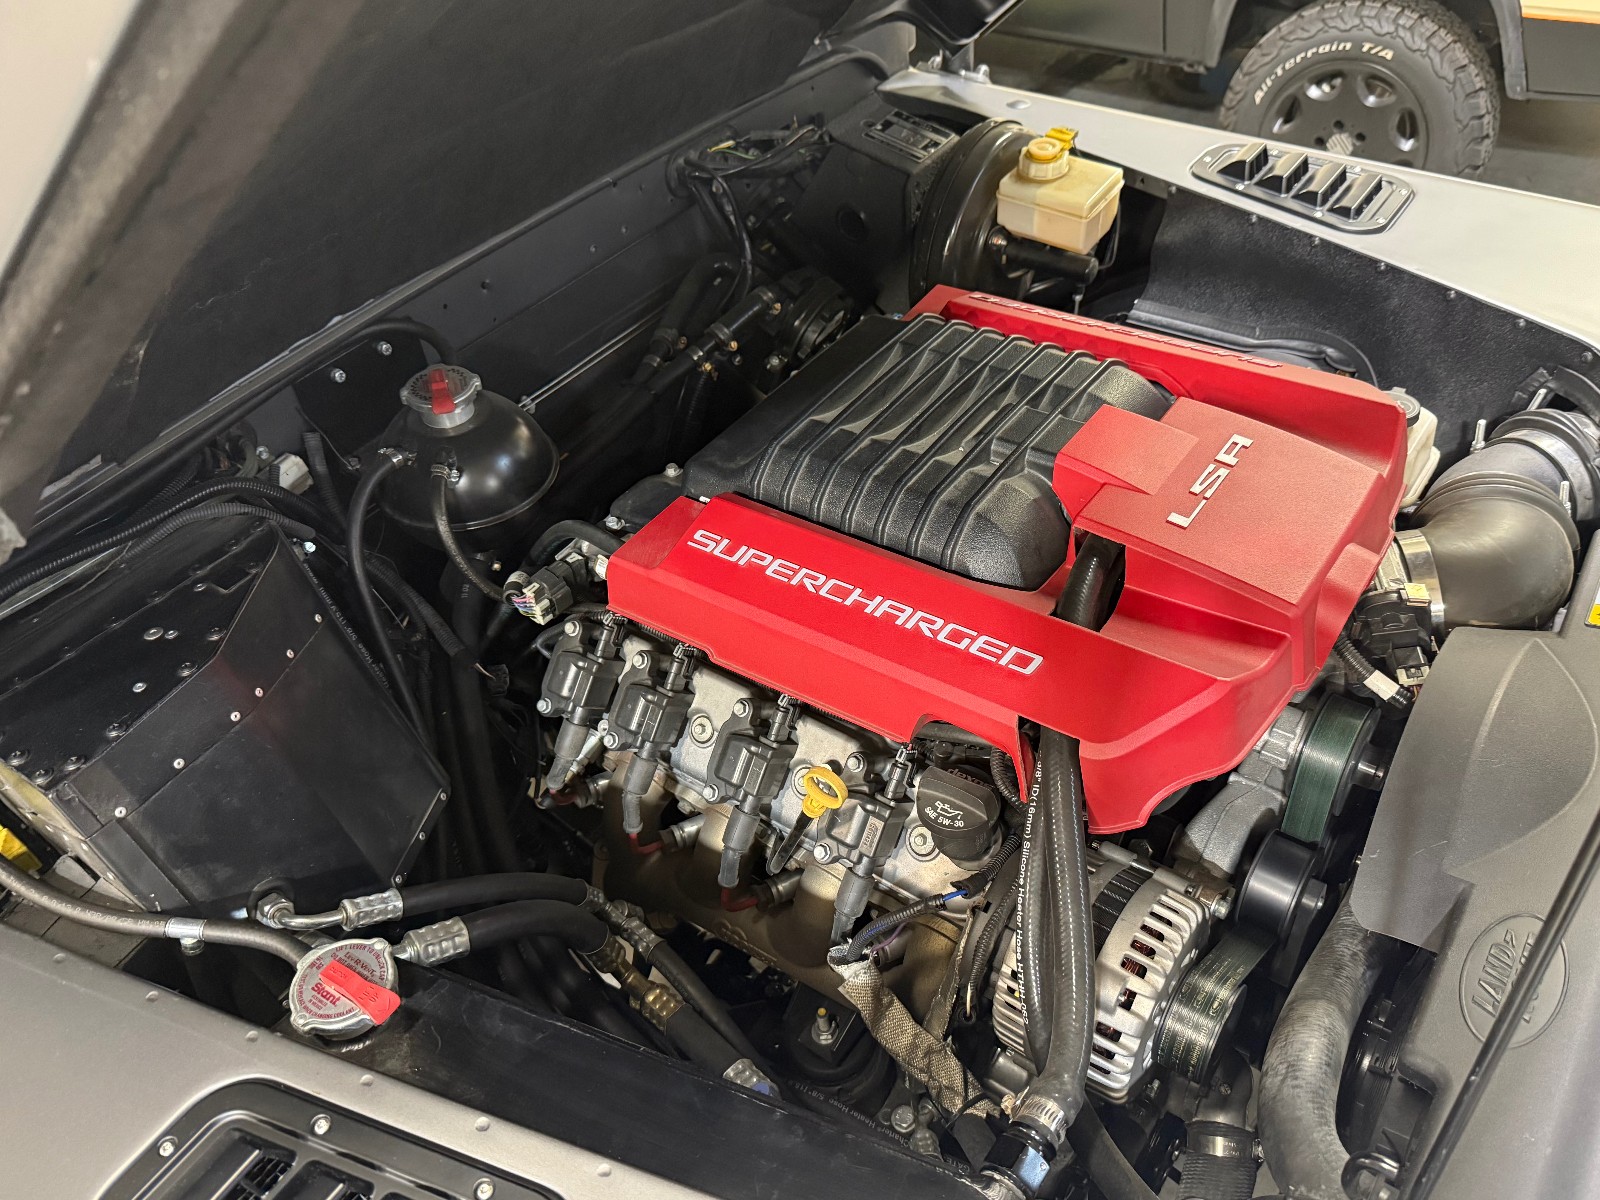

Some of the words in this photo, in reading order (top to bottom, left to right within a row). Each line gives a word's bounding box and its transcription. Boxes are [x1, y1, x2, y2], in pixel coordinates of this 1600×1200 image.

[1253, 41, 1353, 106] All-Terrain
[1361, 41, 1395, 61] T/A
[1165, 433, 1254, 530] LSA
[686, 528, 1045, 676] SUPERCHARGED
[924, 806, 938, 820] SAE
[937, 818, 964, 828] 5W-30
[1018, 841, 1031, 885] Silicone
[1016, 887, 1025, 928] Heater
[311, 981, 341, 1007] Stant
[1472, 943, 1516, 1018] LAND
[828, 1099, 849, 1113] Hose
[851, 1111, 876, 1129] Heater
